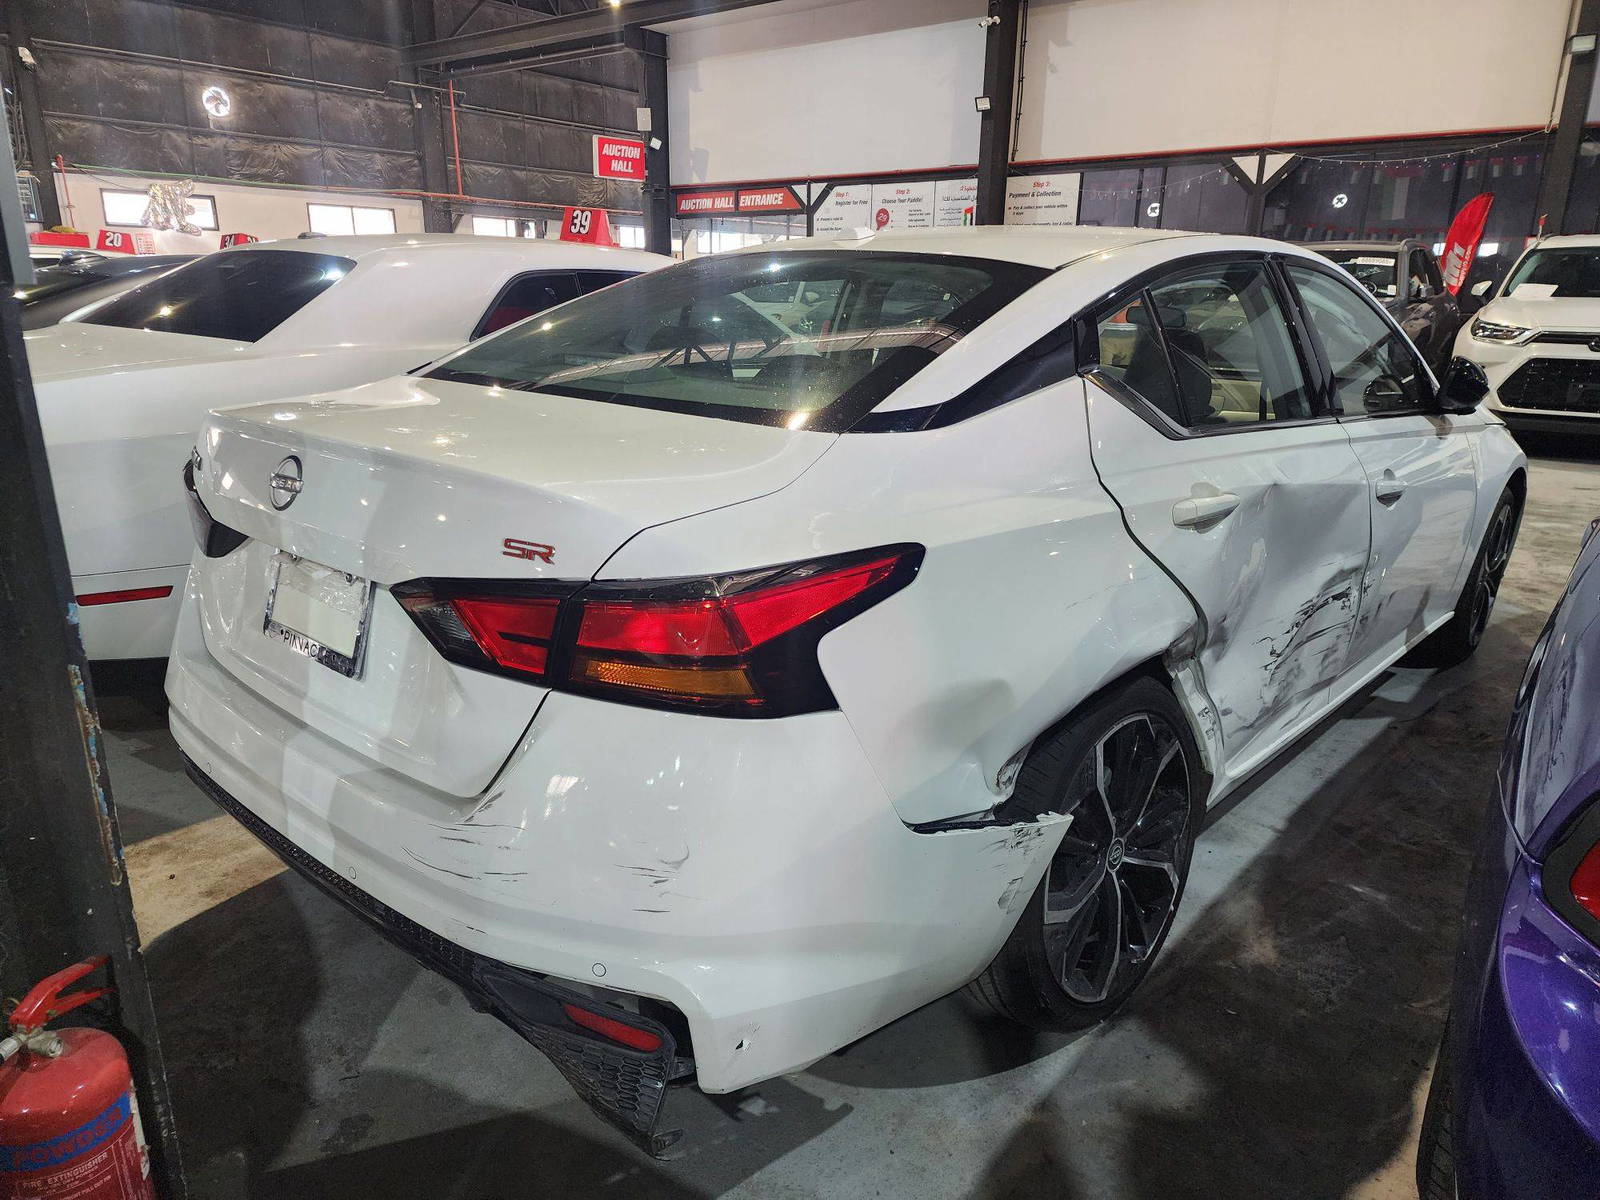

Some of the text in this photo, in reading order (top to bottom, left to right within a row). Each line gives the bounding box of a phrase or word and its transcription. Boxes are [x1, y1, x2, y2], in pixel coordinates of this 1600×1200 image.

[602, 143, 641, 160] AUCTION
[611, 159, 634, 173] HALL
[680, 194, 735, 210] AUCTION HALL
[739, 192, 784, 207] ENTRANCE
[835, 191, 845, 199] Step
[1008, 191, 1031, 199] Payment
[1036, 190, 1062, 198] Collection
[570, 210, 592, 234] 39
[105, 231, 122, 247] 20
[502, 538, 556, 565] SR
[11, 1106, 122, 1169] POWDER
[23, 1179, 42, 1190] FIRE
[47, 1151, 108, 1185] EXTINGUISHER
